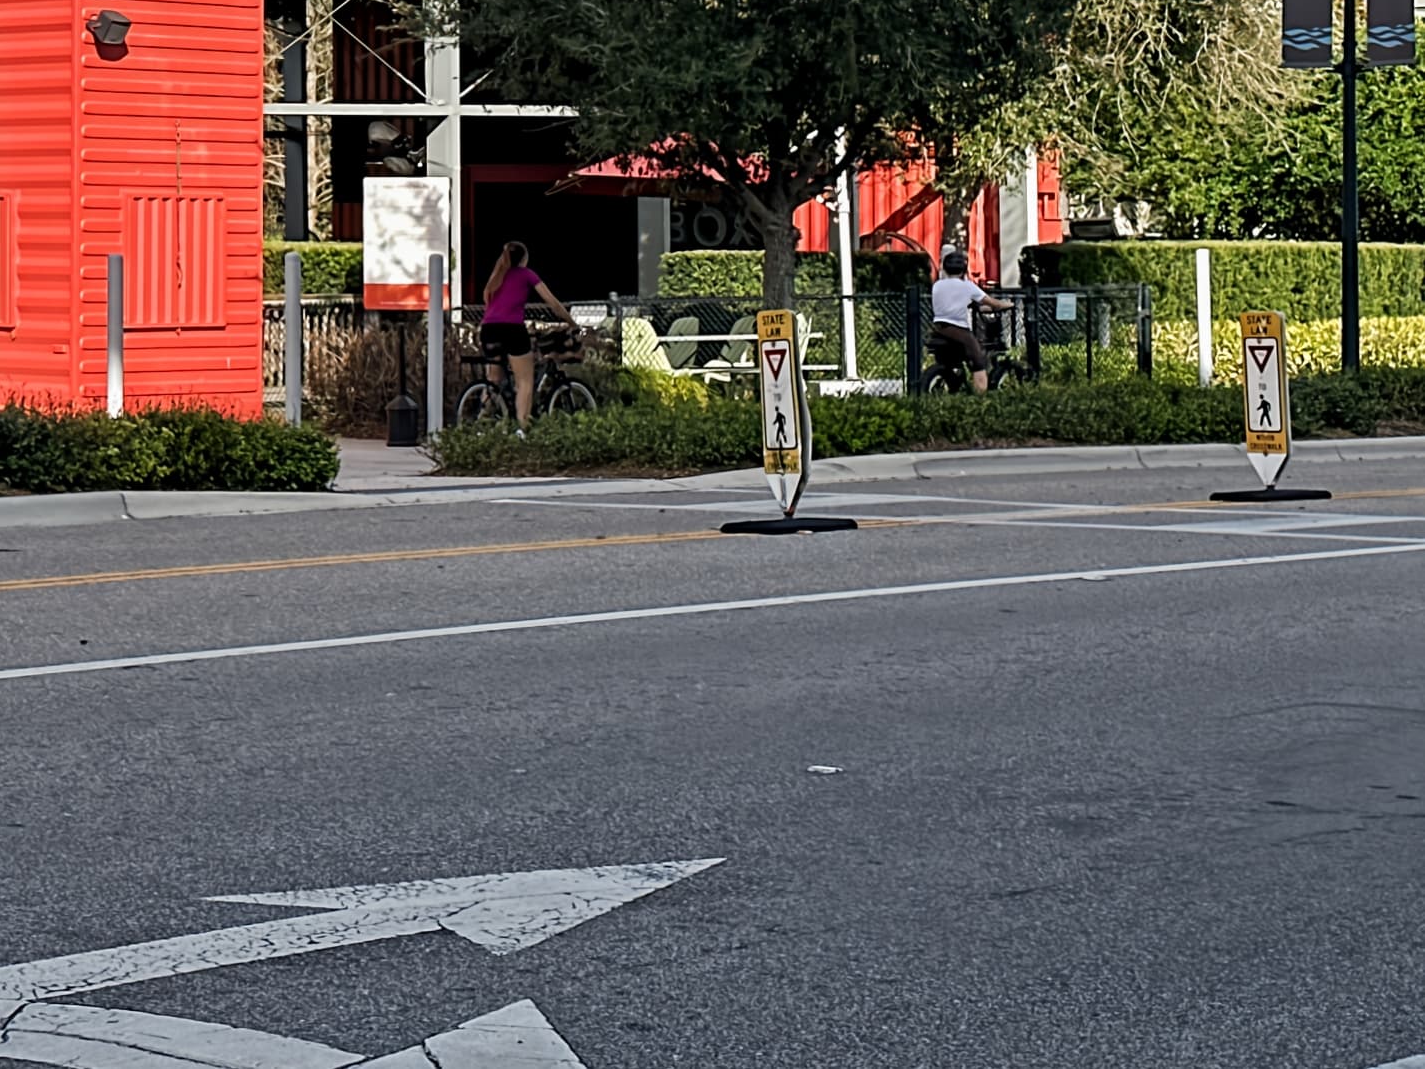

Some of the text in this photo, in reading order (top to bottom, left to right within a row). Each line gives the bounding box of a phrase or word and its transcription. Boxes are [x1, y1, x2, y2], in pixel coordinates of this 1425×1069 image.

[762, 314, 784, 326] STATE
[1246, 315, 1272, 325] STATE
[765, 327, 781, 338] LAW
[1250, 326, 1268, 336] LAW
